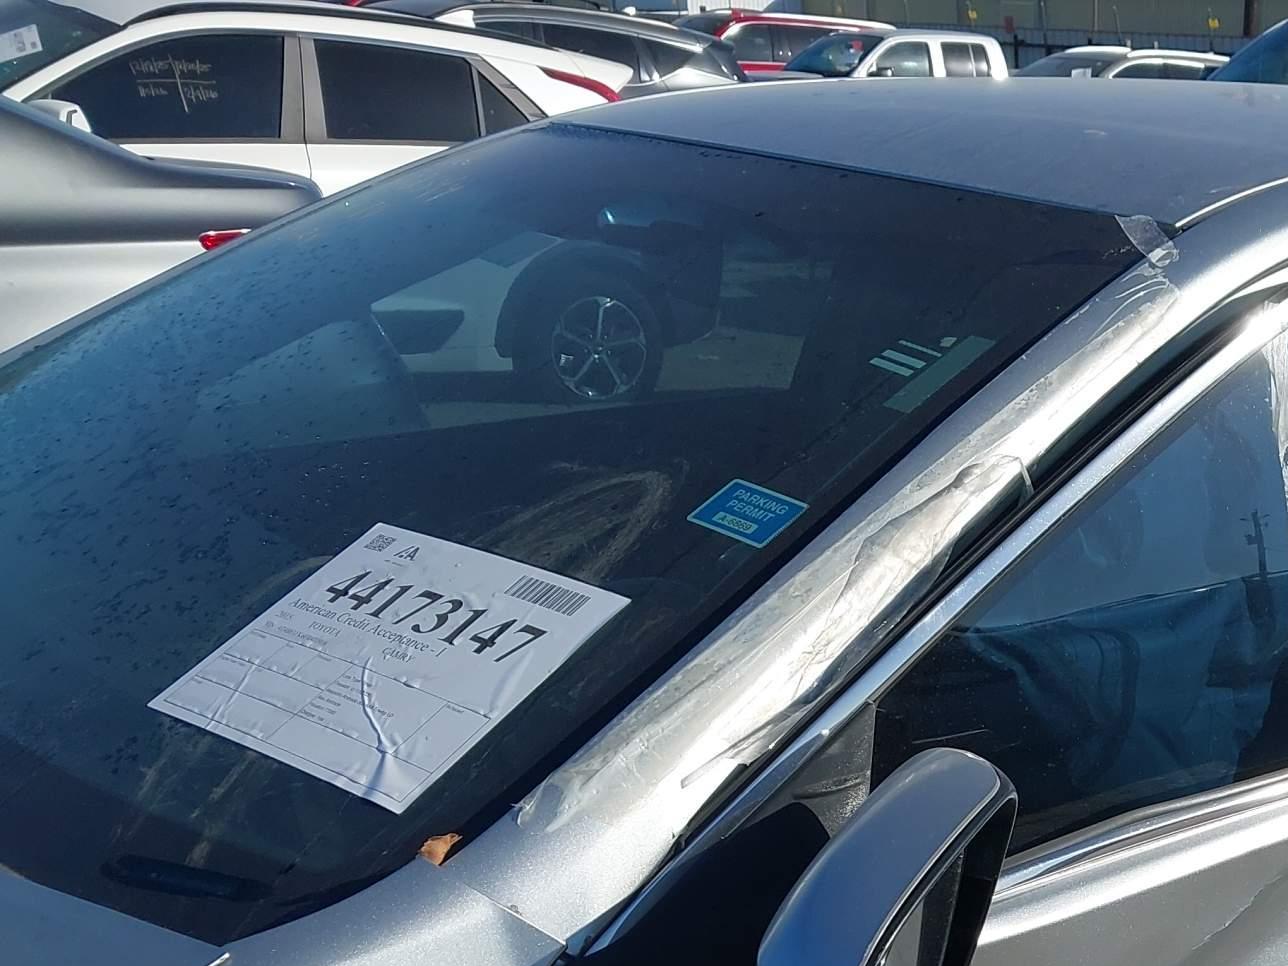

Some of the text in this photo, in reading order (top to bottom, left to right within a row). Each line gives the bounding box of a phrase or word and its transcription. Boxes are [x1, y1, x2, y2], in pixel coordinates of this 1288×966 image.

[726, 499, 776, 522] PERMIT
[732, 488, 789, 515] PARKING
[288, 598, 337, 620] American
[336, 611, 369, 632] Credit
[369, 623, 430, 652] Acceptance
[326, 571, 548, 662] 44173147
[309, 620, 341, 638] TOYOTA
[381, 647, 416, 664] CAMRY
